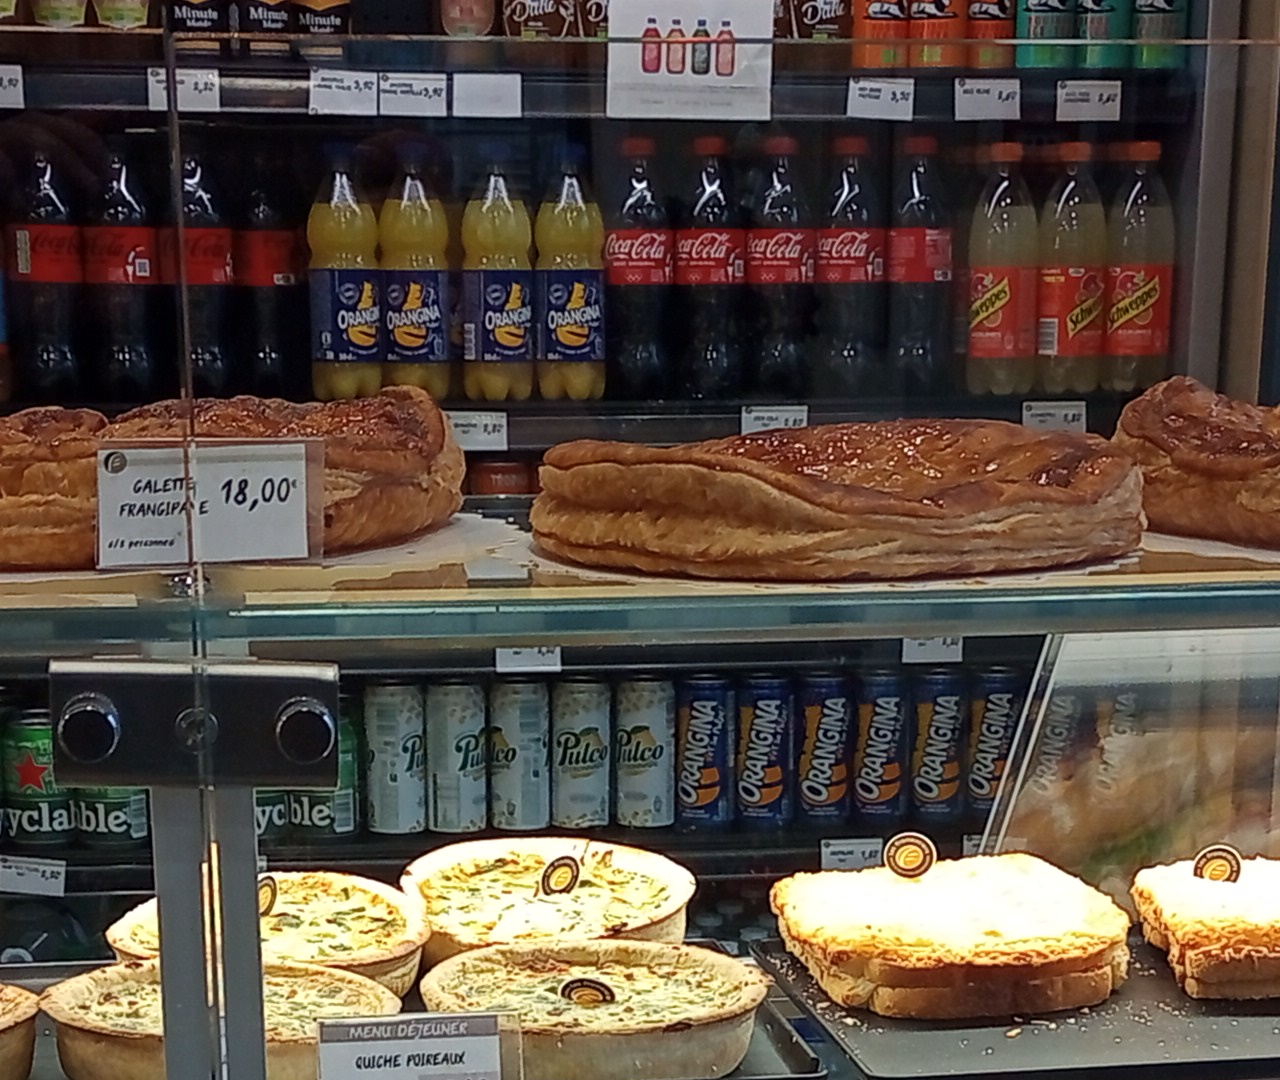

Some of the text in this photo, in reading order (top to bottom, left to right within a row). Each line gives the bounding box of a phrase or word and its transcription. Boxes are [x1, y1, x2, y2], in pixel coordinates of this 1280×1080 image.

[174, 6, 218, 20] Minute
[248, 7, 288, 21] Minute
[298, 13, 342, 26] Minute
[606, 233, 667, 259] Coca-Cola
[677, 233, 730, 259] ca-Cola
[818, 232, 870, 259] ca-Cola
[386, 304, 441, 330] ORANGINA
[548, 304, 600, 330] ORANGINA
[1109, 284, 1158, 327] Schweppes
[120, 500, 209, 518] FRANGIPAE
[556, 731, 608, 768] Pulco
[617, 728, 664, 763] Pulco
[677, 700, 718, 804] ORANGINA
[738, 699, 781, 804] ORANGINA
[801, 697, 847, 803] ORANGINA
[855, 696, 900, 801] ORANGINA
[914, 695, 960, 800] ORANGINA
[967, 693, 1012, 796] ORANGINA
[349, 1019, 469, 1040] MENU DÉJEUNER
[355, 1051, 465, 1070] QUICHE POIREAUX
